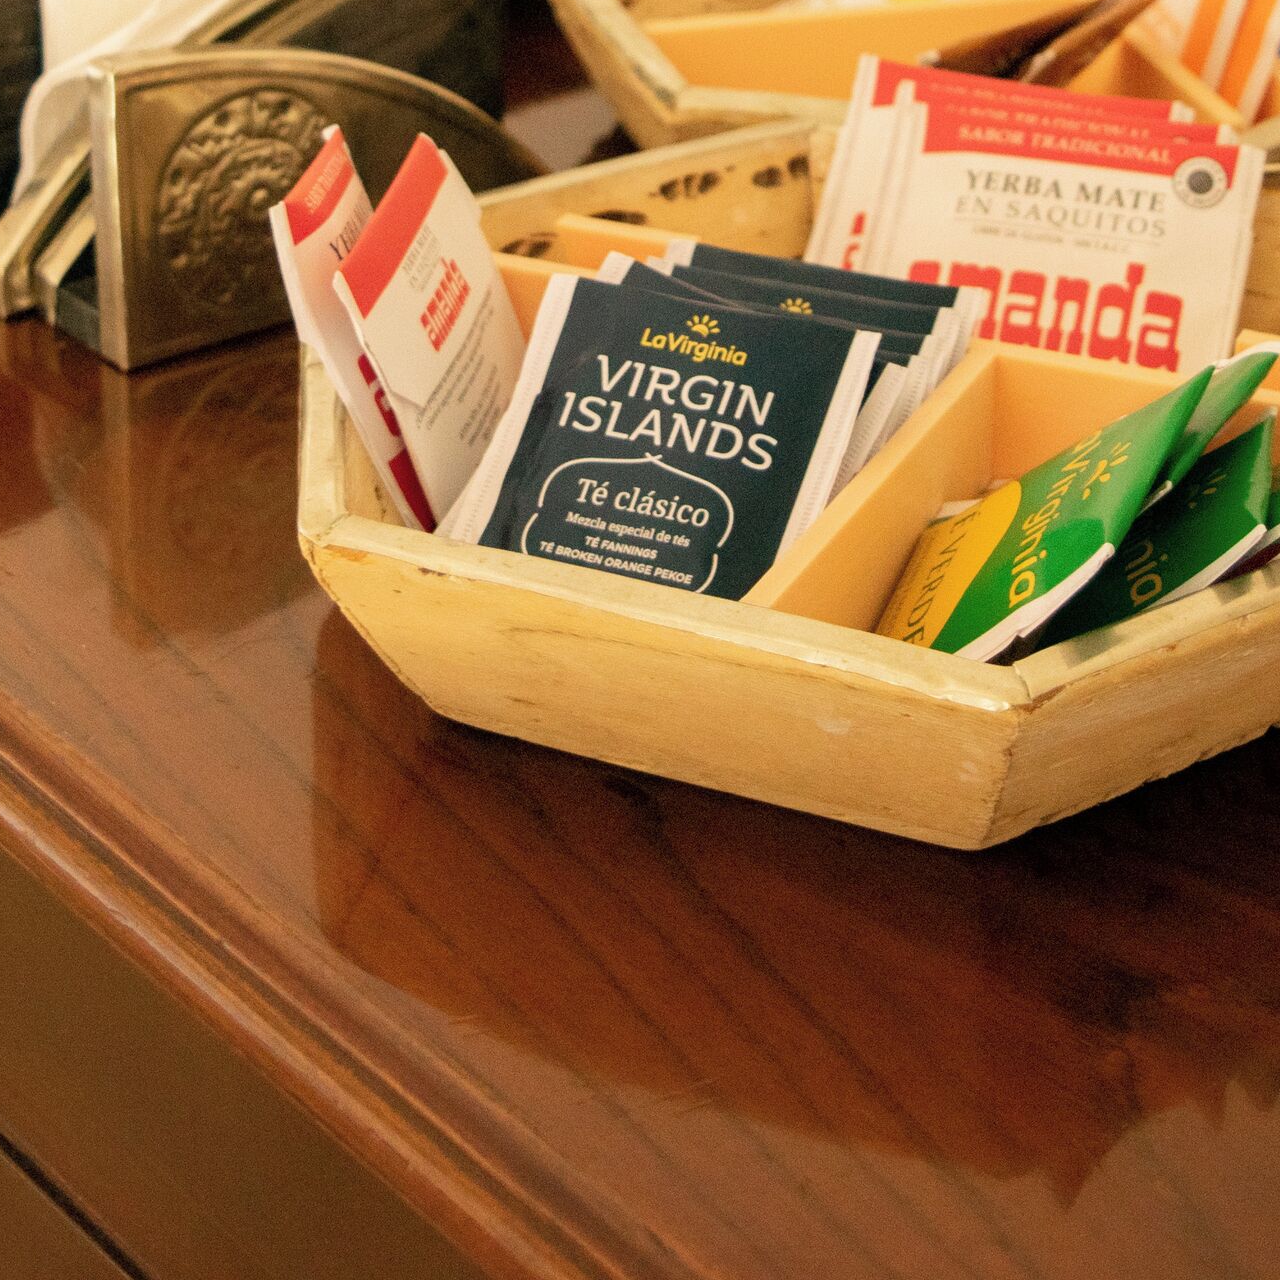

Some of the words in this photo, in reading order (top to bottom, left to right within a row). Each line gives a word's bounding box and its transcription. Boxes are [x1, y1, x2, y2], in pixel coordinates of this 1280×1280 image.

[959, 124, 1024, 145] SABOR
[1029, 131, 1173, 165] TRADICIONAL
[965, 169, 1066, 201] YERBA
[1077, 183, 1166, 213] MATE
[955, 195, 997, 215] EN
[1006, 201, 1167, 238] SAQUITOS
[640, 328, 748, 366] LaVirginia
[597, 354, 774, 426] VIRGIN
[558, 391, 778, 471] ISLANDS
[576, 477, 608, 506] Té
[614, 486, 709, 528] clásico
[565, 511, 607, 531] Mezcla
[608, 521, 655, 541] especial
[655, 529, 671, 544] de
[672, 532, 690, 548] tés
[585, 534, 600, 548] TÉ
[601, 540, 658, 560] FANNINGS
[540, 539, 555, 554] TÉ
[555, 545, 603, 566] BROKEN
[604, 556, 653, 576] ORANGE
[654, 567, 693, 585] PEKOE
